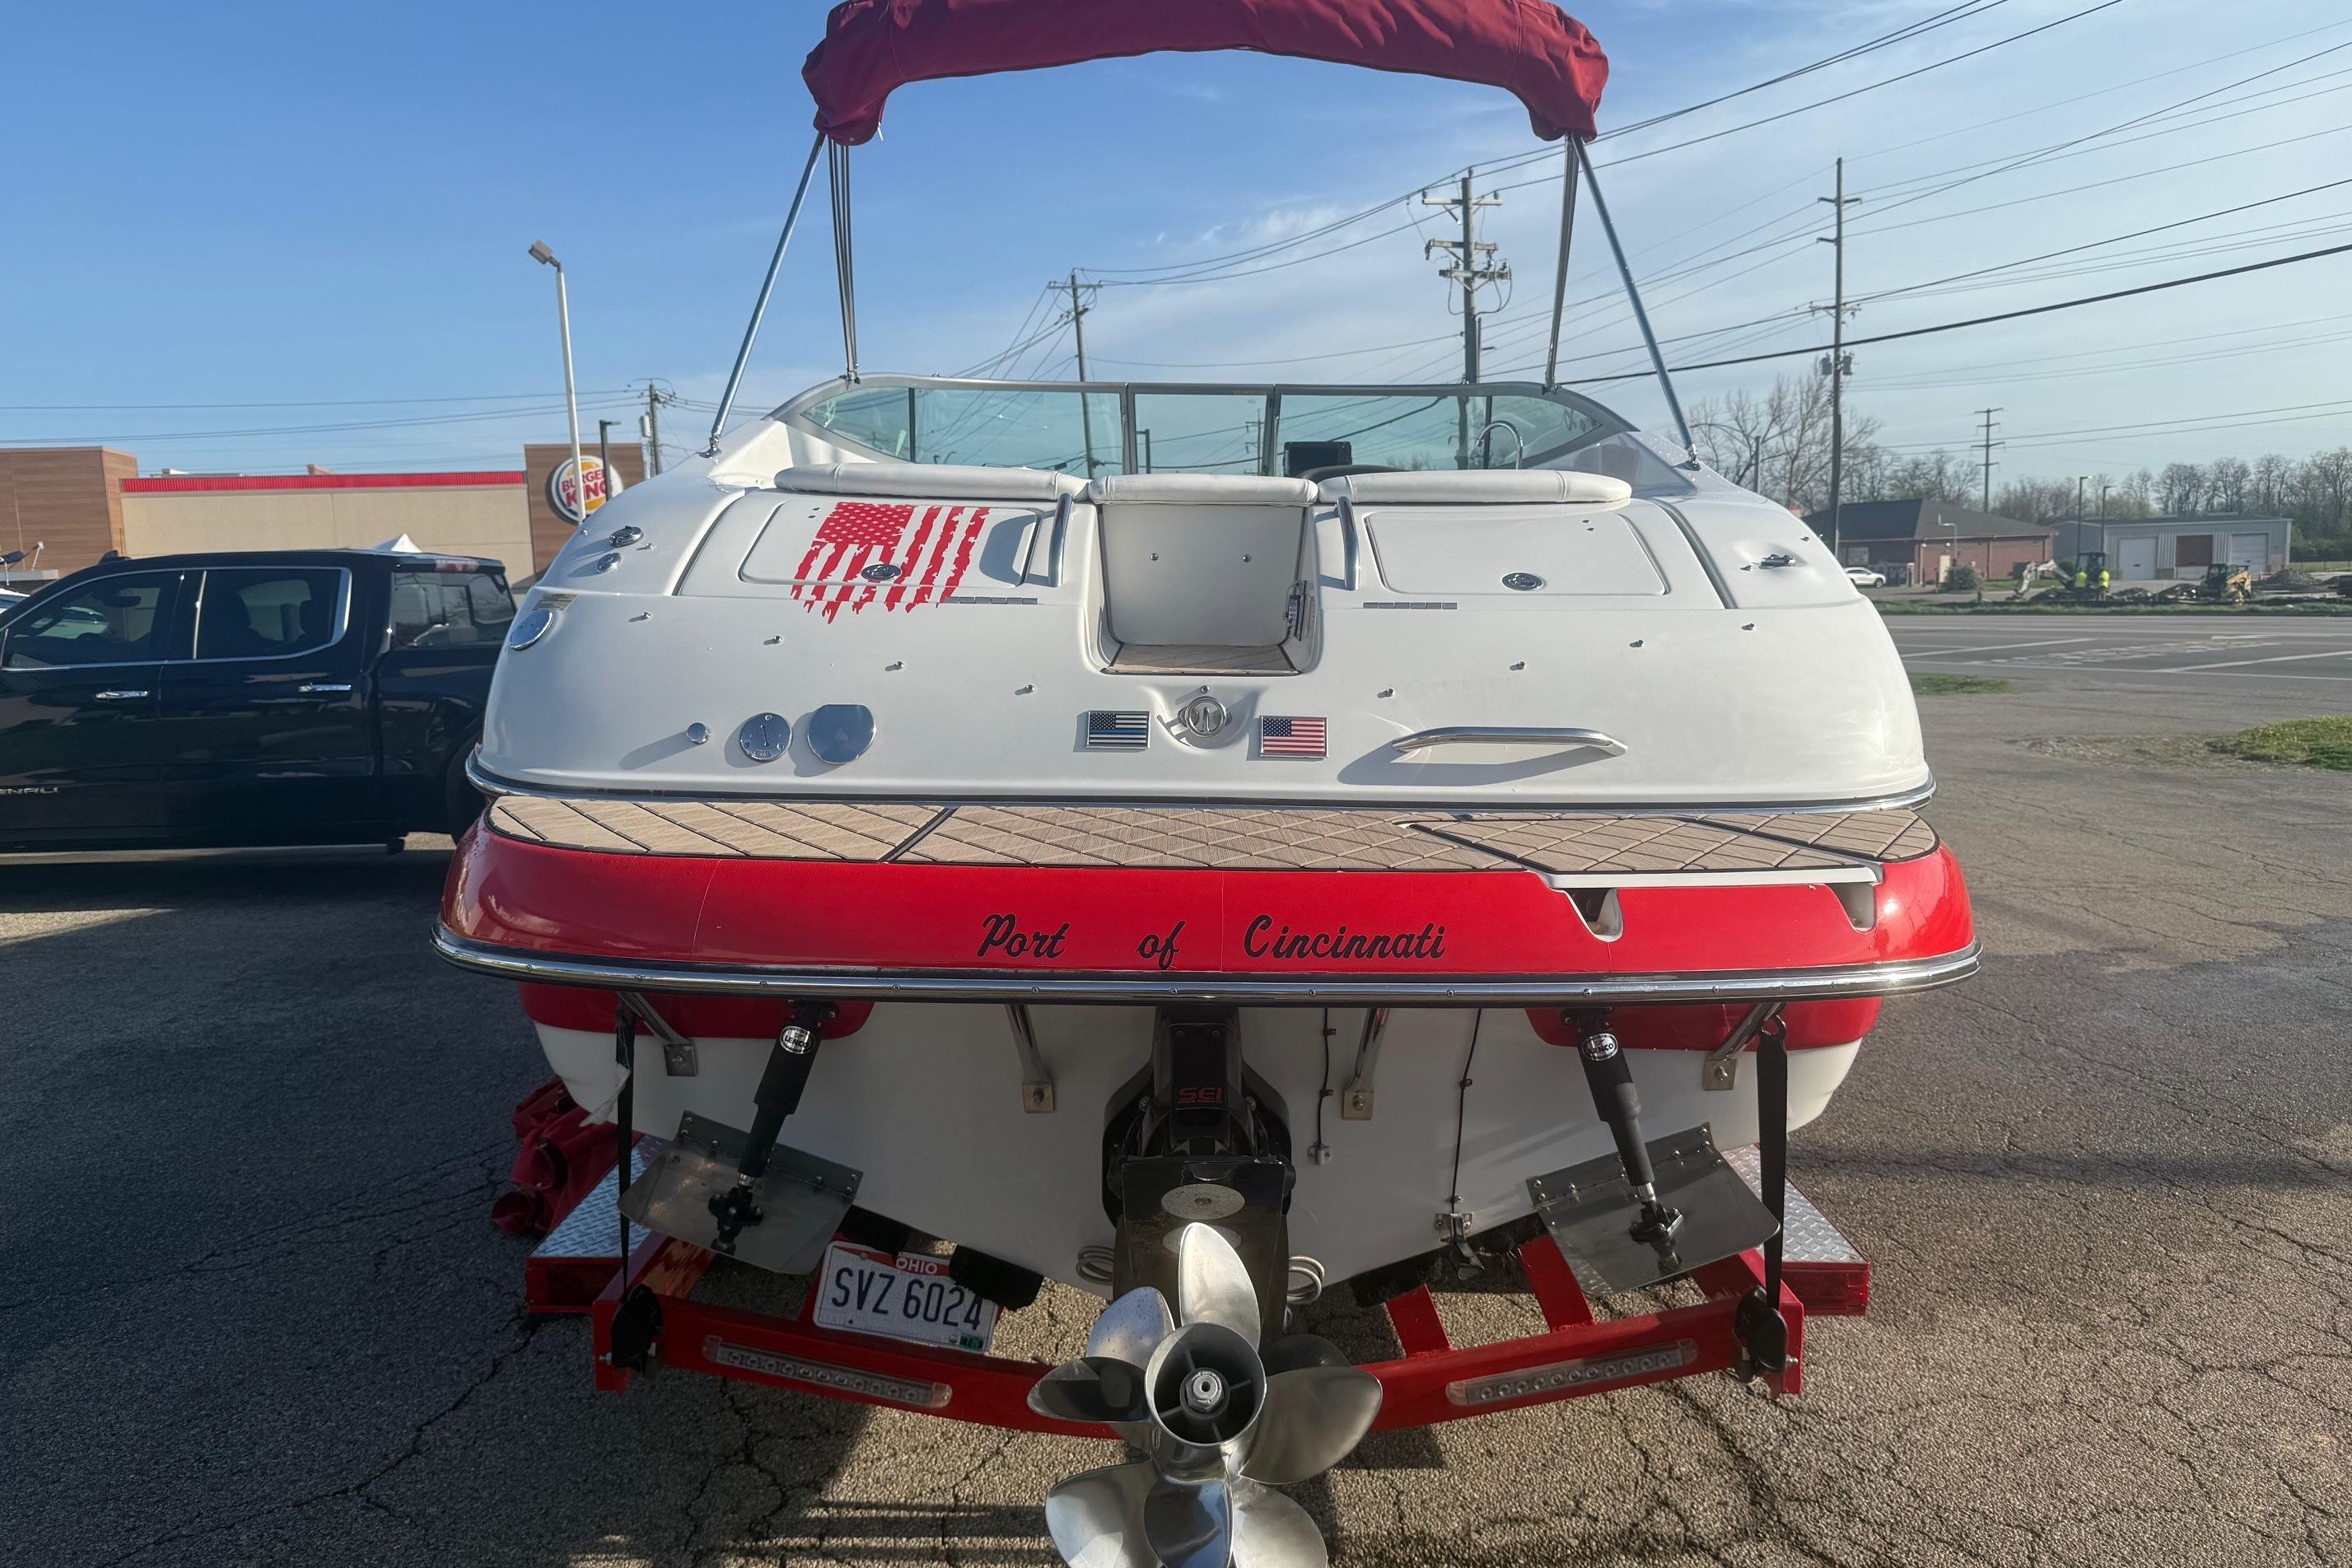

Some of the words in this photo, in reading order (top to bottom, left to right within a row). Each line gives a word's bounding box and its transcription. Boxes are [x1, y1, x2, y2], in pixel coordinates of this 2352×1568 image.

[977, 913, 1070, 959] Port
[1137, 921, 1185, 969] of
[1244, 914, 1446, 959] Cincinnati
[1178, 1086, 1223, 1100] SEI
[895, 1256, 938, 1275] OHIO
[831, 1267, 896, 1314] SVZ
[903, 1278, 983, 1330] 6024
